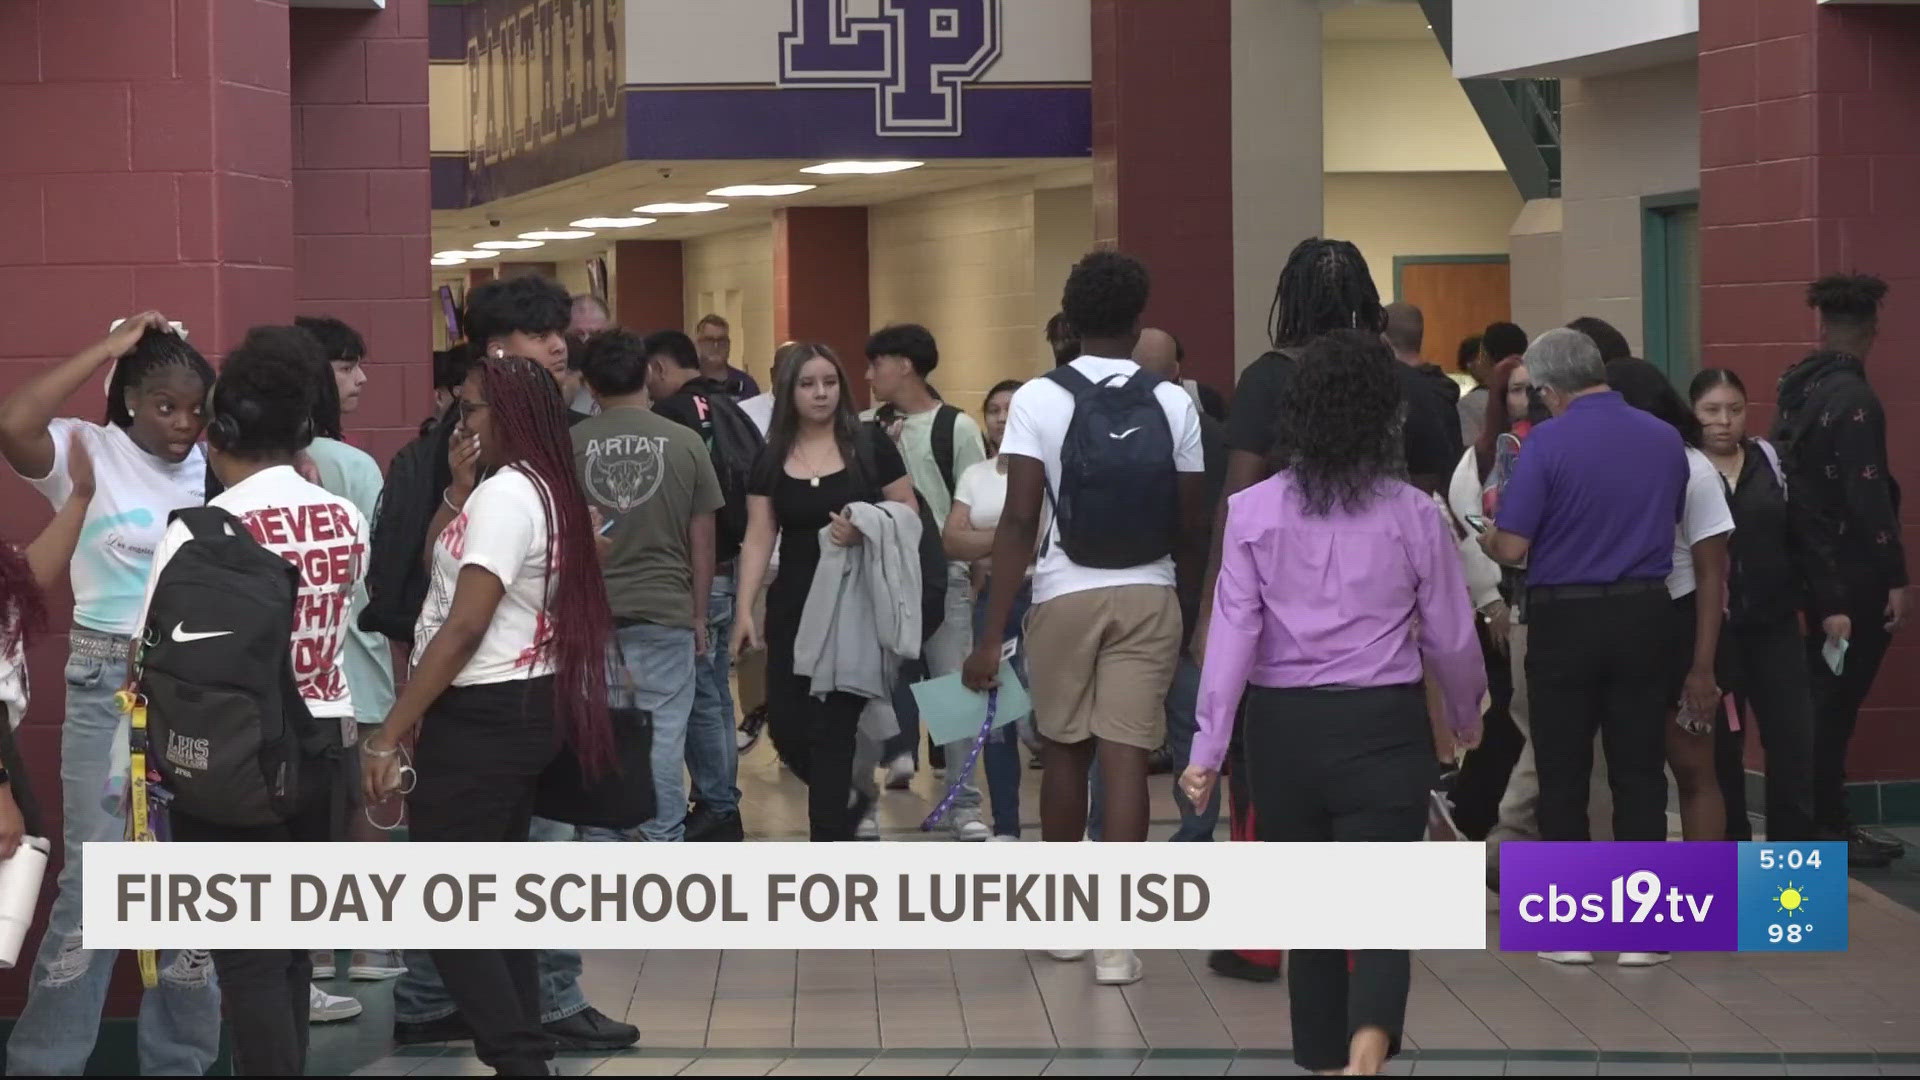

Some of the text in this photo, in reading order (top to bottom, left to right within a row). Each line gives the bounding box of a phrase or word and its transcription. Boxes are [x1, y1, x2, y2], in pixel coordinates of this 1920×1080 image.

[468, 0, 618, 171] PANTHERS
[776, 0, 1001, 136] LP
[585, 434, 669, 456] ARIAT
[281, 543, 365, 588] RGET
[289, 633, 338, 675] OU
[166, 728, 210, 761] LHS
